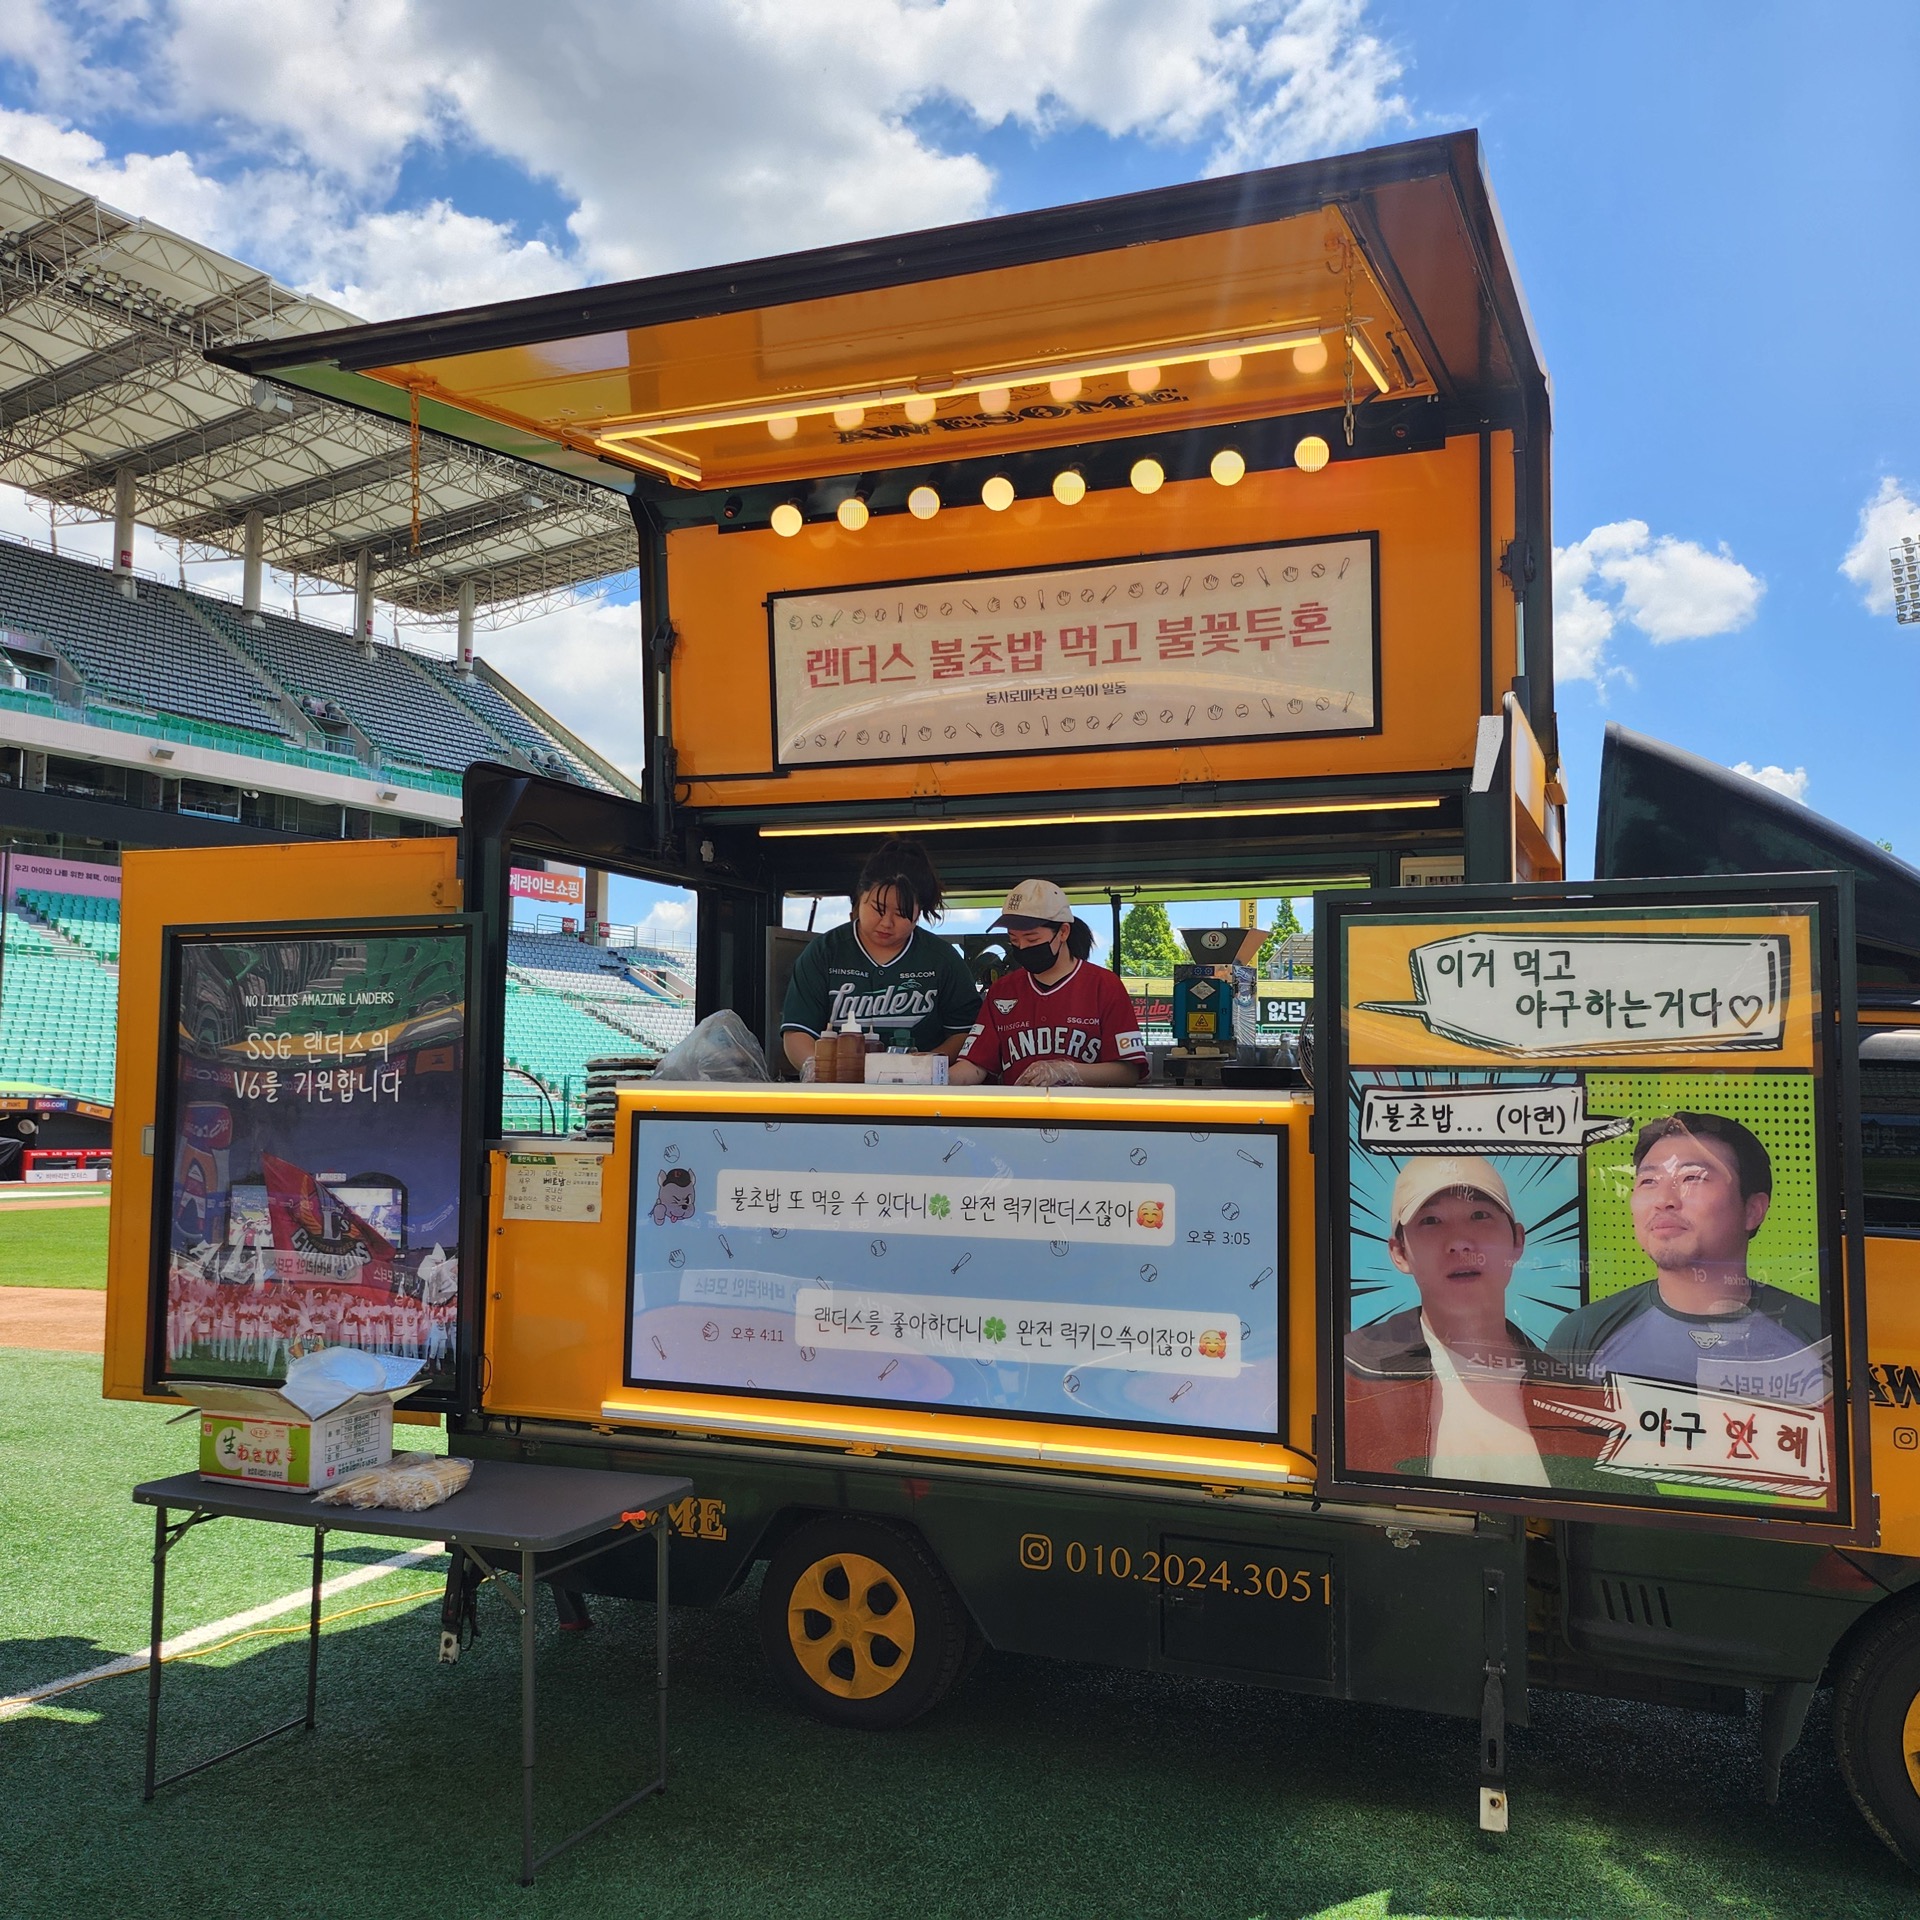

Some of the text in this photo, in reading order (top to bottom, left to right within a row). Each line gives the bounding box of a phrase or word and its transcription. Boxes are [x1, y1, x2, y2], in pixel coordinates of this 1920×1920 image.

[806, 601, 1331, 688] 랜더스 불초밥 먹고 불꽃투혼
[986, 681, 1127, 705] 동사로마닷컴 으쓱이 일동
[14, 864, 29, 873] 우리
[54, 868, 68, 877] 나를
[70, 870, 85, 880] 위한
[828, 967, 869, 978] SHINSEGAE
[899, 970, 936, 979] SSG.COM
[1436, 947, 1575, 990] 이거 먹고
[245, 992, 395, 1006] NO LIMITS AMAZING LANDERS
[828, 983, 938, 1023] Landers
[1267, 1001, 1306, 1022] 없던
[1515, 987, 1720, 1030] 야구하는거다
[997, 1021, 1030, 1032] HINSEGAE
[1066, 1017, 1100, 1026] SSG.COM
[246, 1030, 391, 1063] SSG 랜더스의
[1002, 1027, 1102, 1071] LANDERS
[234, 1071, 282, 1103] V6를
[294, 1069, 402, 1103] 기원합니다
[1495, 1103, 1567, 1137] (아련)
[730, 1185, 780, 1213] 불초밥
[787, 1188, 805, 1212] 또
[812, 1188, 845, 1215] 먹을
[851, 1193, 870, 1214] 수
[876, 1191, 928, 1218] 있다니
[960, 1194, 996, 1222] 완전
[1002, 1194, 1134, 1229] 럭키랜더스잖아
[1187, 1229, 1251, 1247] 오후 3:05
[731, 1325, 784, 1342] 오후 4:11
[813, 1304, 1196, 1360] 랜더스를 좋아하다니 완전 럭키으쓱이잖앙
[1639, 1406, 1809, 1467] 야구 안 해
[1065, 1541, 1332, 1606] 010.2024.3051
